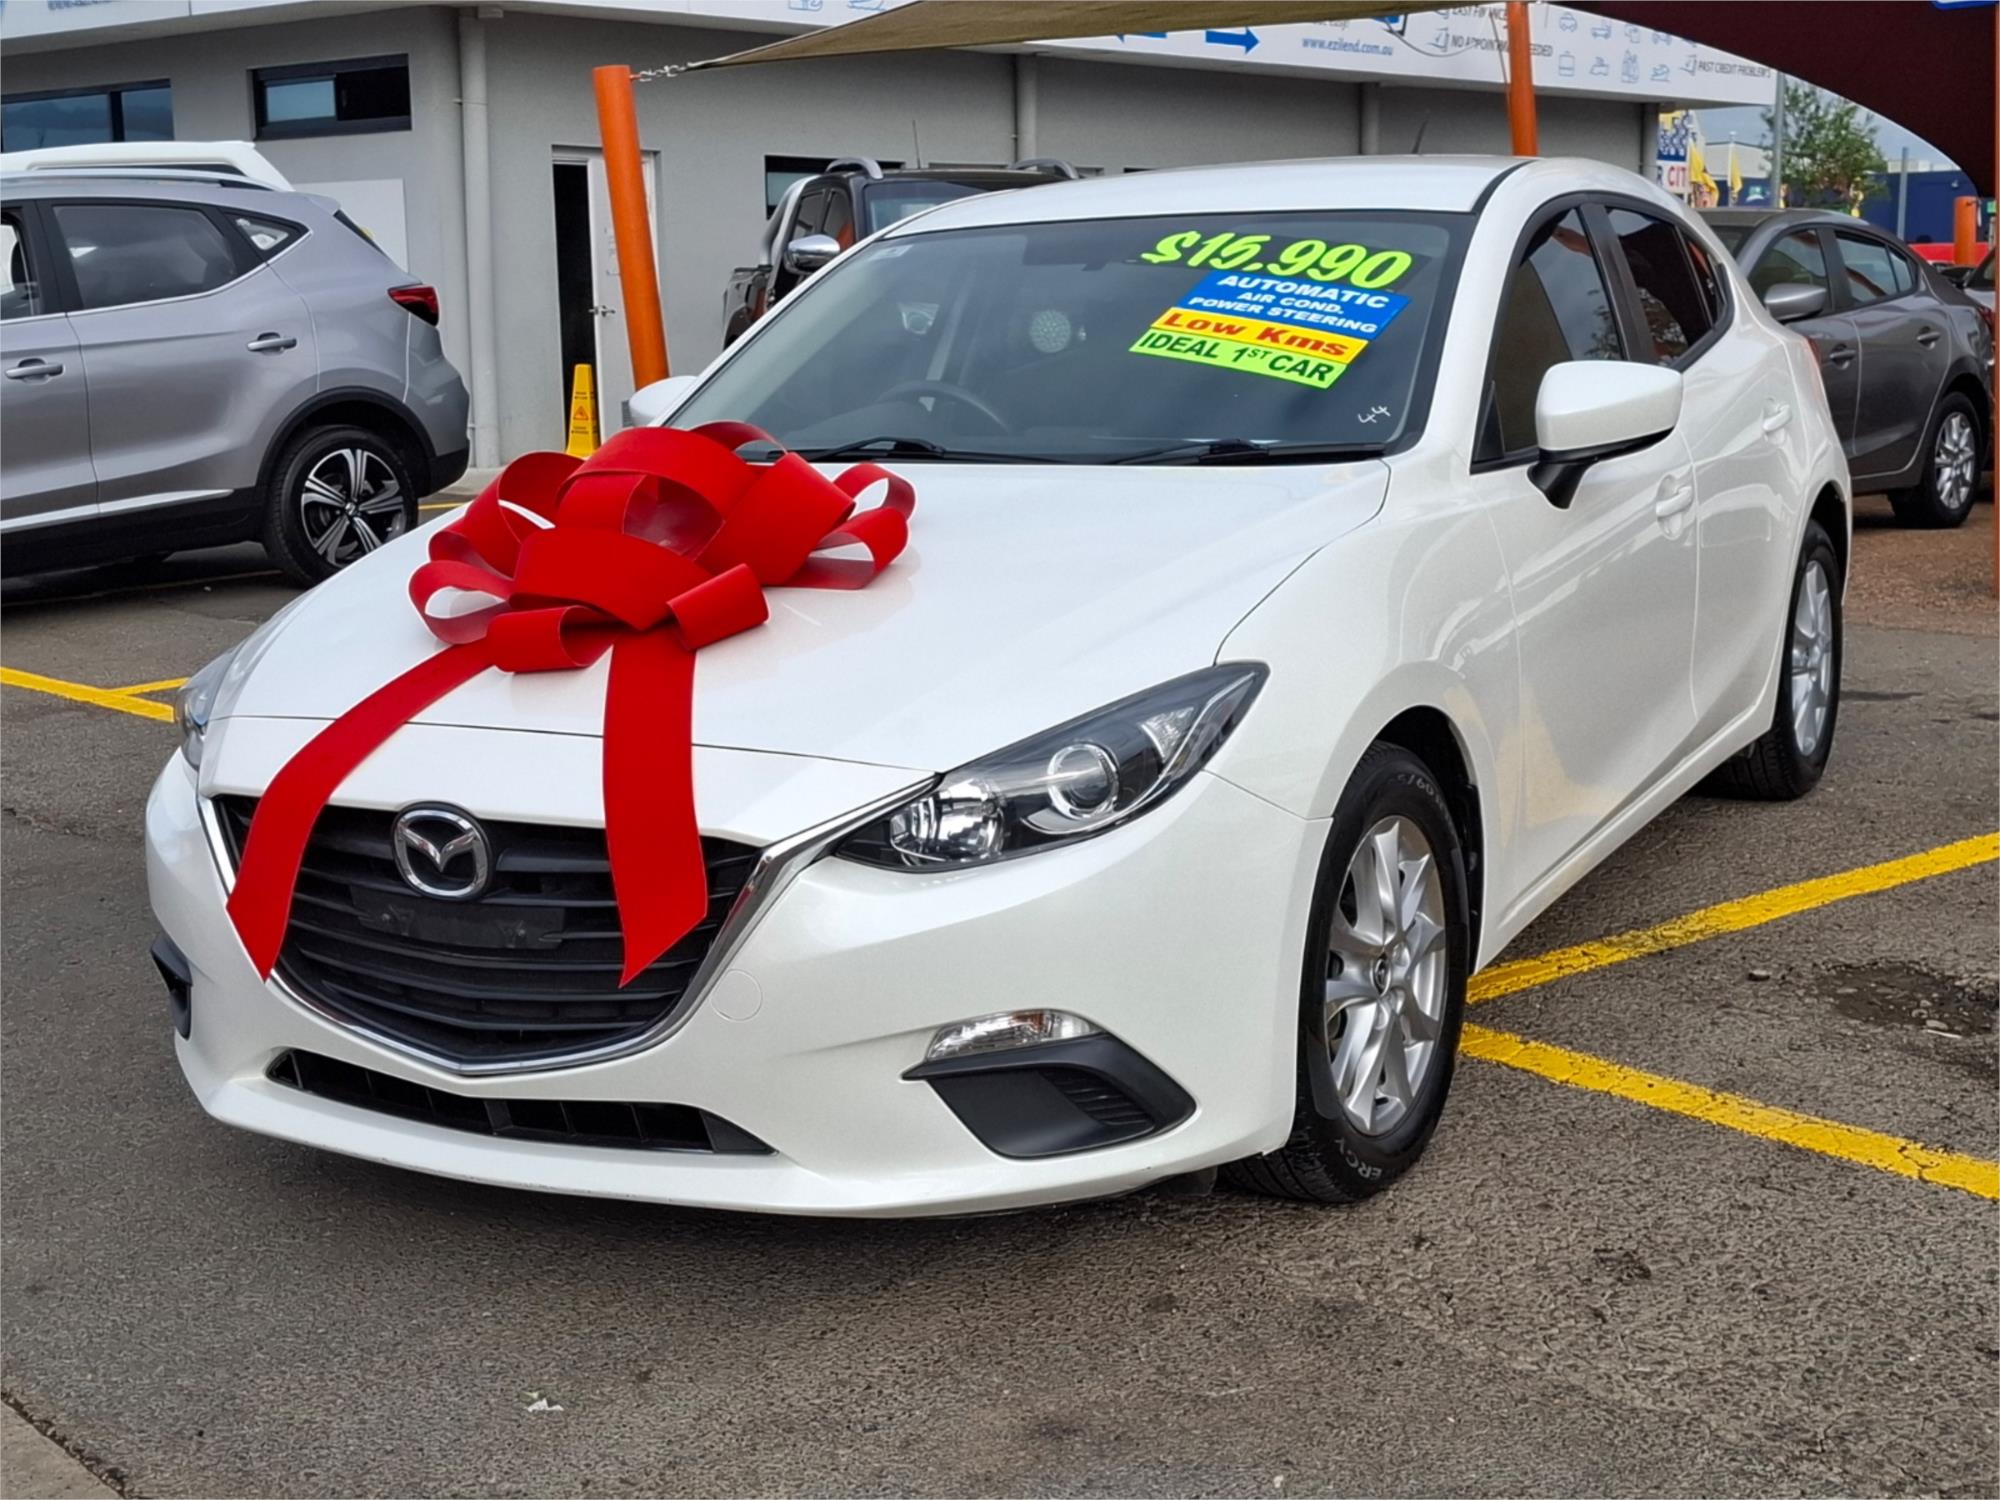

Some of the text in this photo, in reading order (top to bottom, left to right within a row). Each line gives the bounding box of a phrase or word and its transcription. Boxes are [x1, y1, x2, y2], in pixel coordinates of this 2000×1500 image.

[1302, 38, 1393, 56] www.ezilend.com.au
[1452, 35, 1464, 48] NO
[1217, 274, 1389, 309] AUTOMATIC
[1237, 291, 1344, 315] AIR COND.
[1188, 297, 1378, 334] POWER STEERING
[1162, 313, 1349, 357] Low Kms
[1139, 332, 1221, 359] IDEAL
[1268, 354, 1335, 382] CAR
